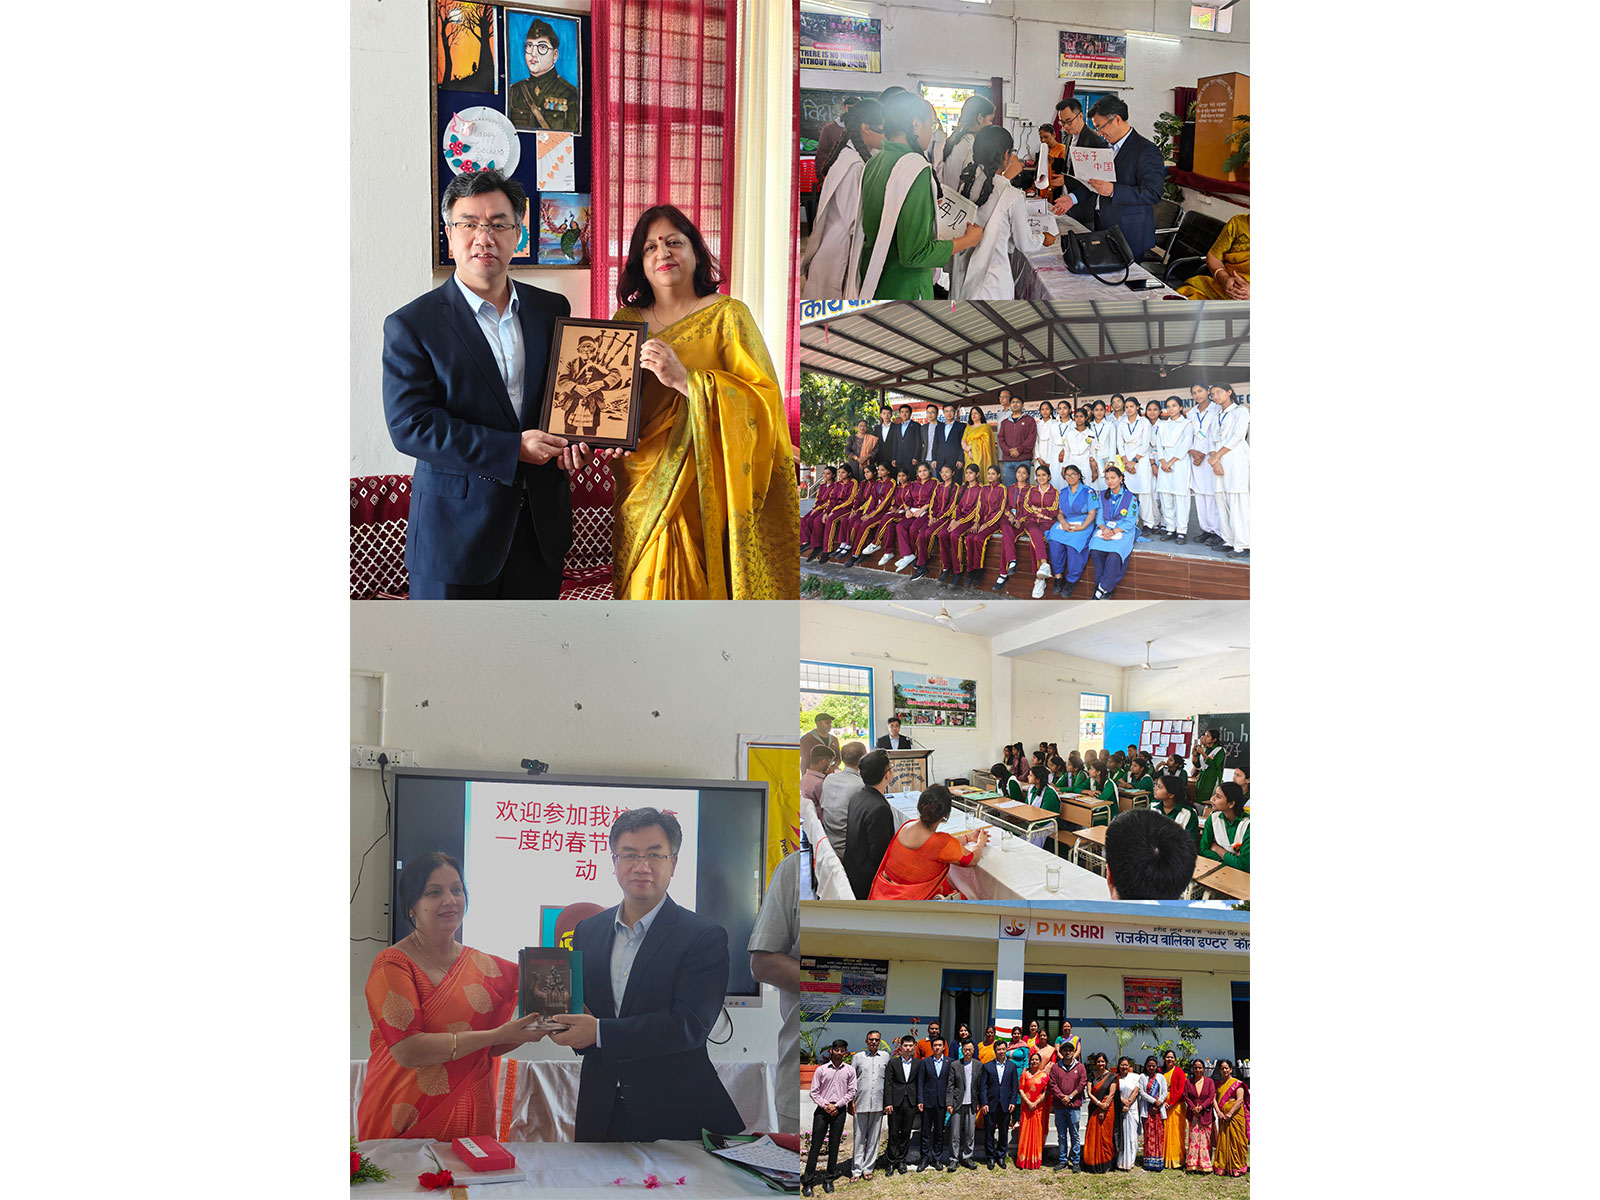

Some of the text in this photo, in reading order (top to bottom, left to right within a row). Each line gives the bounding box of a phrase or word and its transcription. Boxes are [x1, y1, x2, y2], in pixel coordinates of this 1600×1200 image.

[829, 59, 847, 67] HARD
[1093, 162, 1113, 171] 中国
[495, 829, 614, 855] 一度的春节
[575, 860, 597, 881] 动
[1070, 923, 1104, 940] SHRI
[1115, 929, 1159, 945] राजकीय
[1197, 936, 1229, 950] इण्टर
